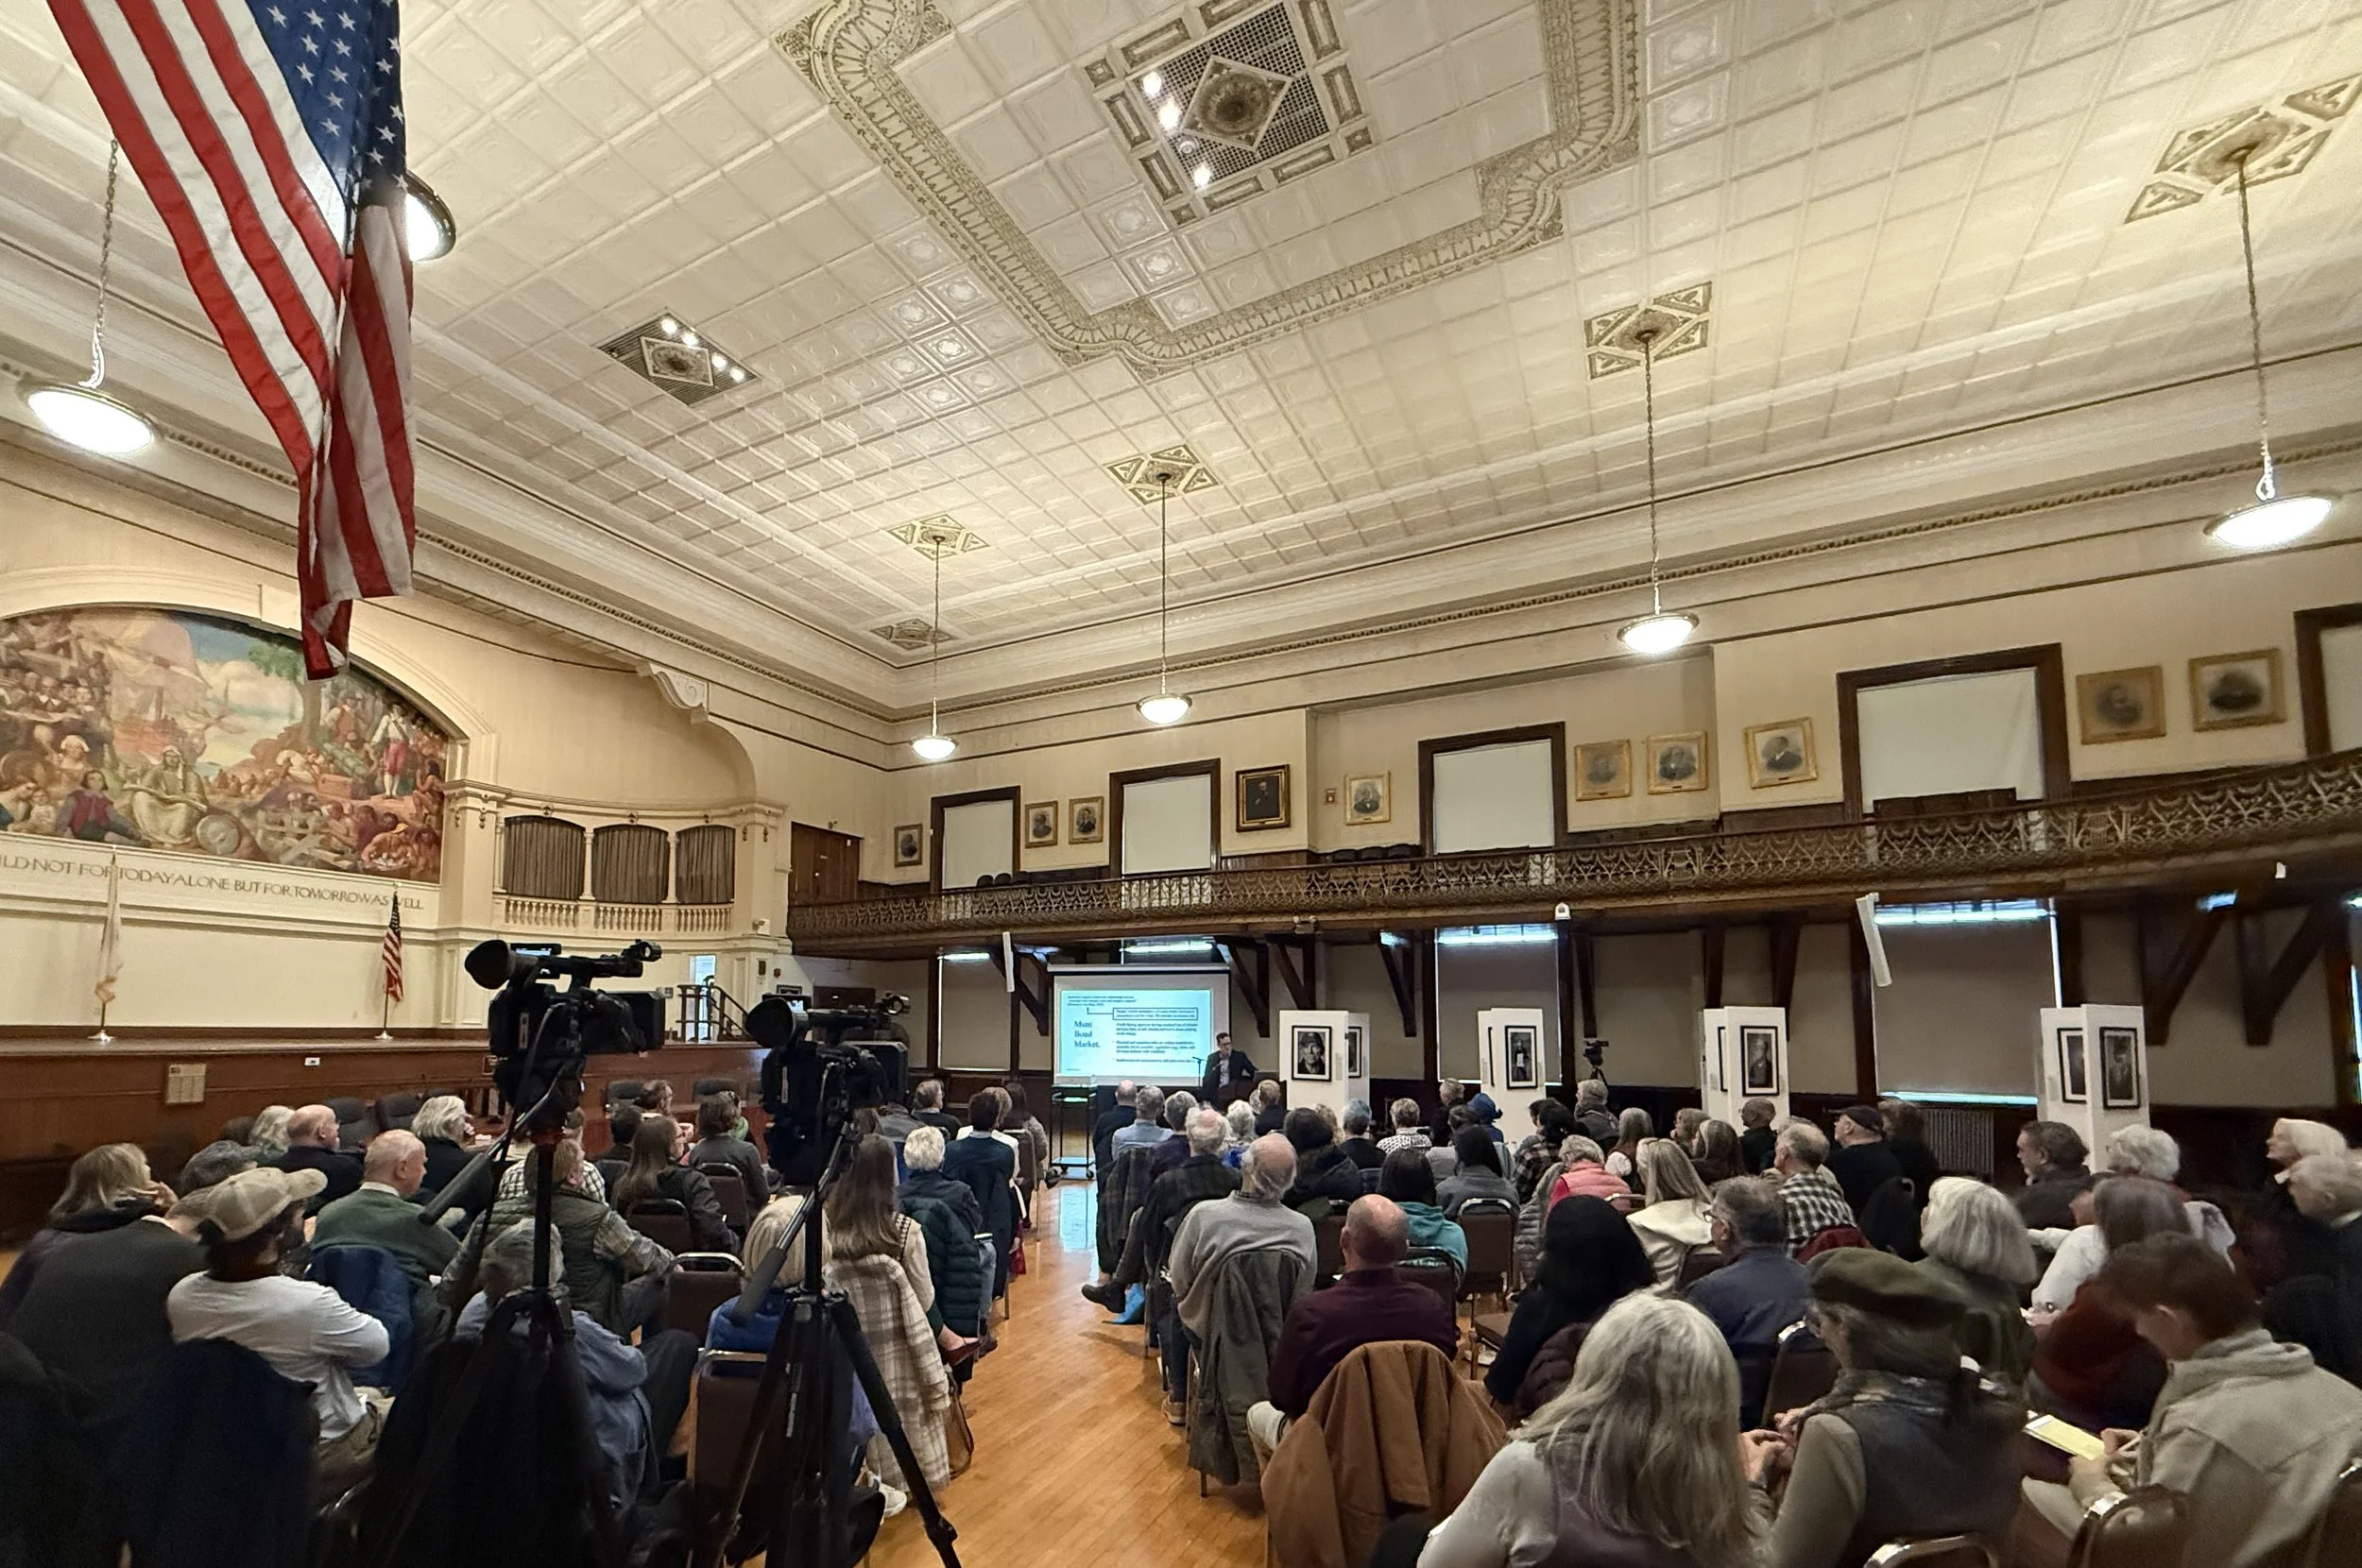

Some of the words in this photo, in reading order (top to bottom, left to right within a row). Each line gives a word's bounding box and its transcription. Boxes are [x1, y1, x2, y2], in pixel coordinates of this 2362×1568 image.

[32, 858, 77, 874] NOT
[117, 866, 174, 884] TODAY
[172, 874, 231, 891] ALONE
[233, 879, 262, 894] BUT
[263, 882, 291, 897] FOR
[294, 885, 373, 904] TOMORROW
[369, 895, 389, 906] AS
[1074, 1030, 1092, 1038] Bond
